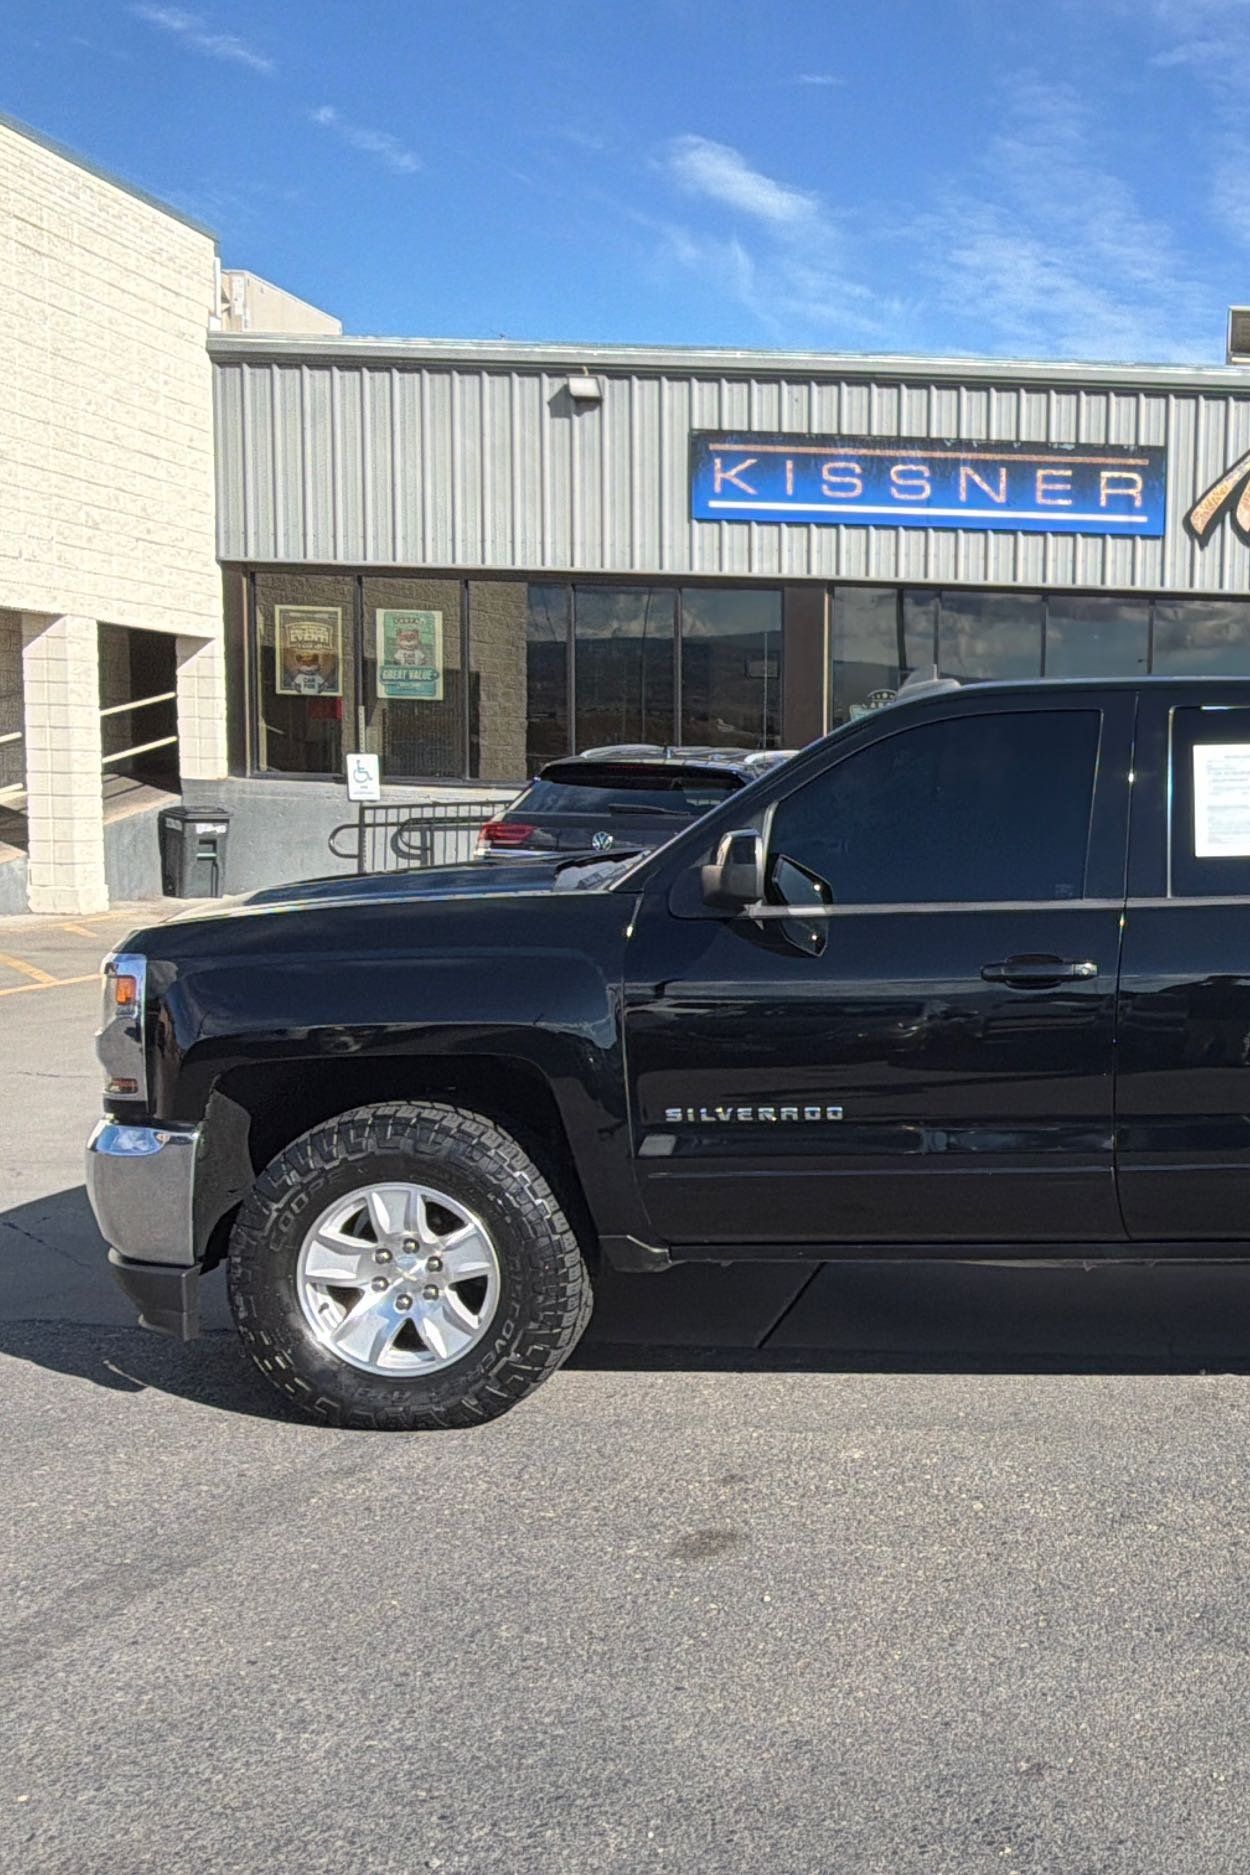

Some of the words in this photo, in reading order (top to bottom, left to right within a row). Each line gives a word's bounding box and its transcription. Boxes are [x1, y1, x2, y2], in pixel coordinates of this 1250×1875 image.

[713, 457, 1144, 508] KISSNER
[409, 669, 431, 681] VALUE
[664, 1106, 844, 1122] SILVERADO
